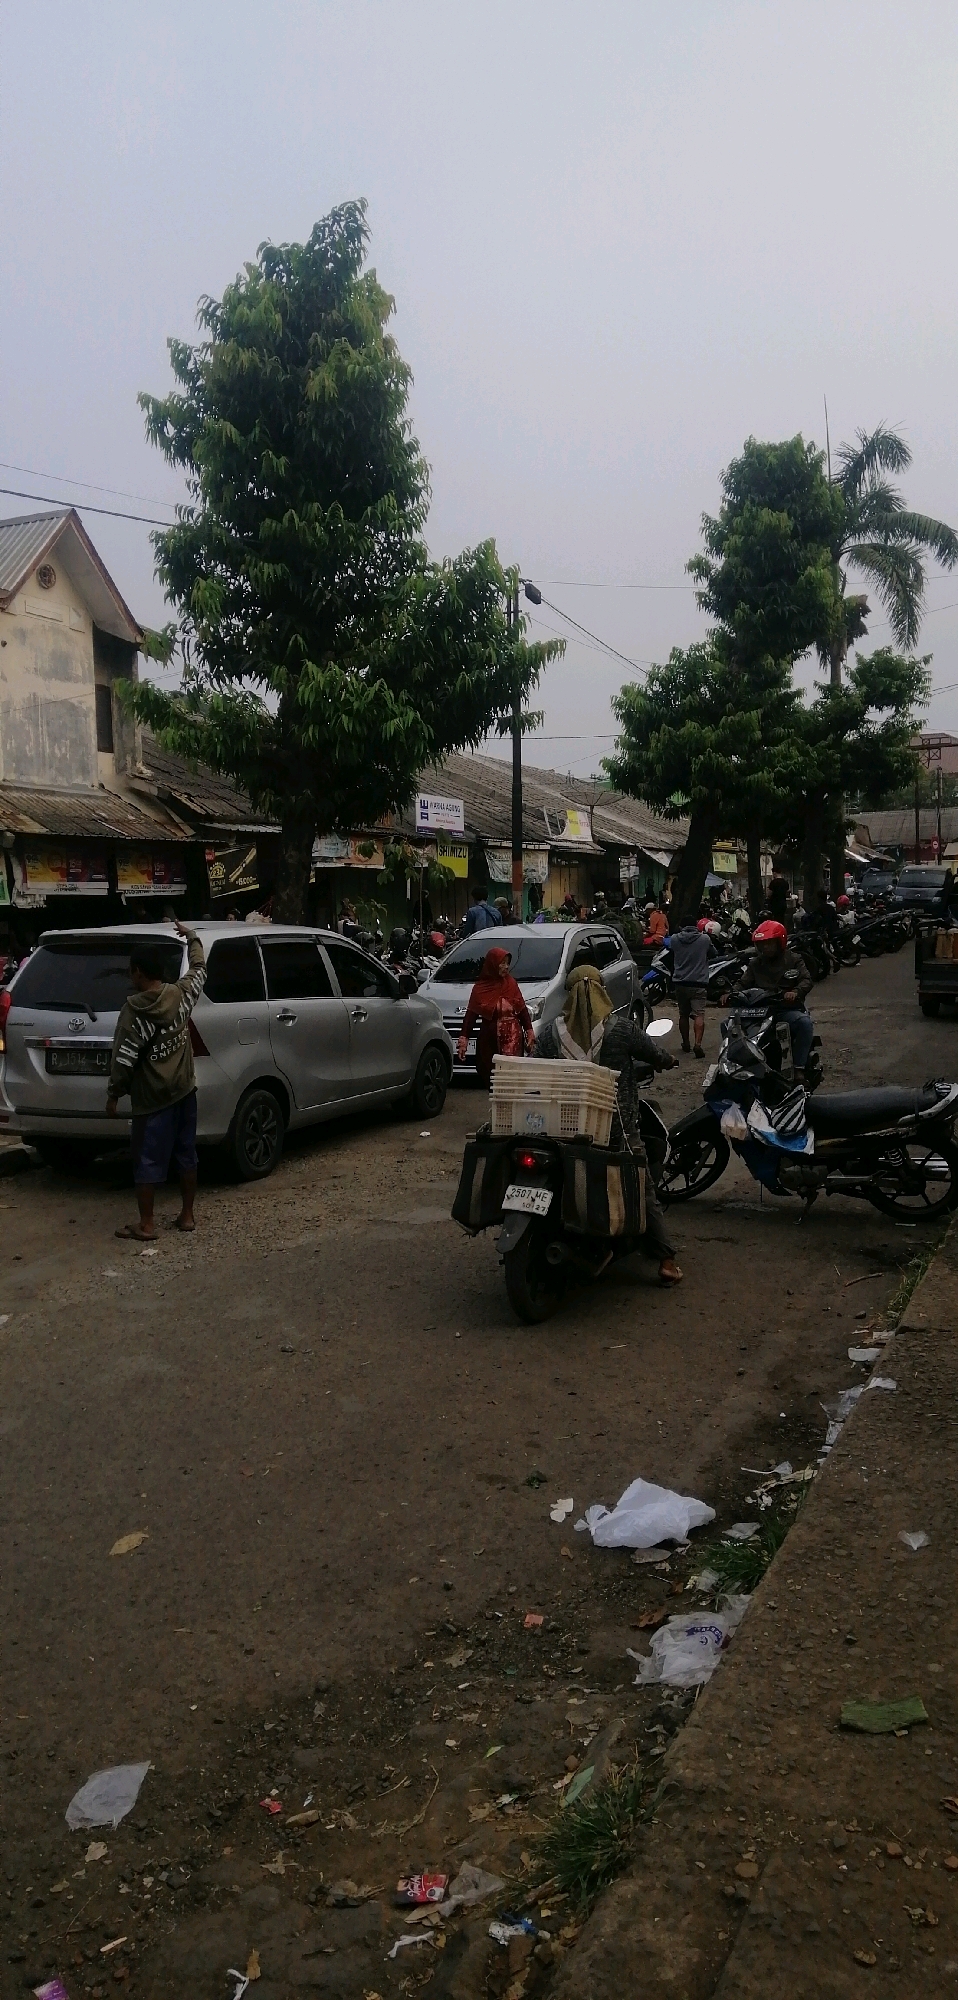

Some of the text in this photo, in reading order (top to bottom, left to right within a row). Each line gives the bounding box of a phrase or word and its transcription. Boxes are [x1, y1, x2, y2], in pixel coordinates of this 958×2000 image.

[438, 845, 467, 859] SHIMIZU
[51, 1052, 58, 1066] R
[96, 1053, 108, 1066] CJ
[511, 1188, 549, 1203] 2507 ME
